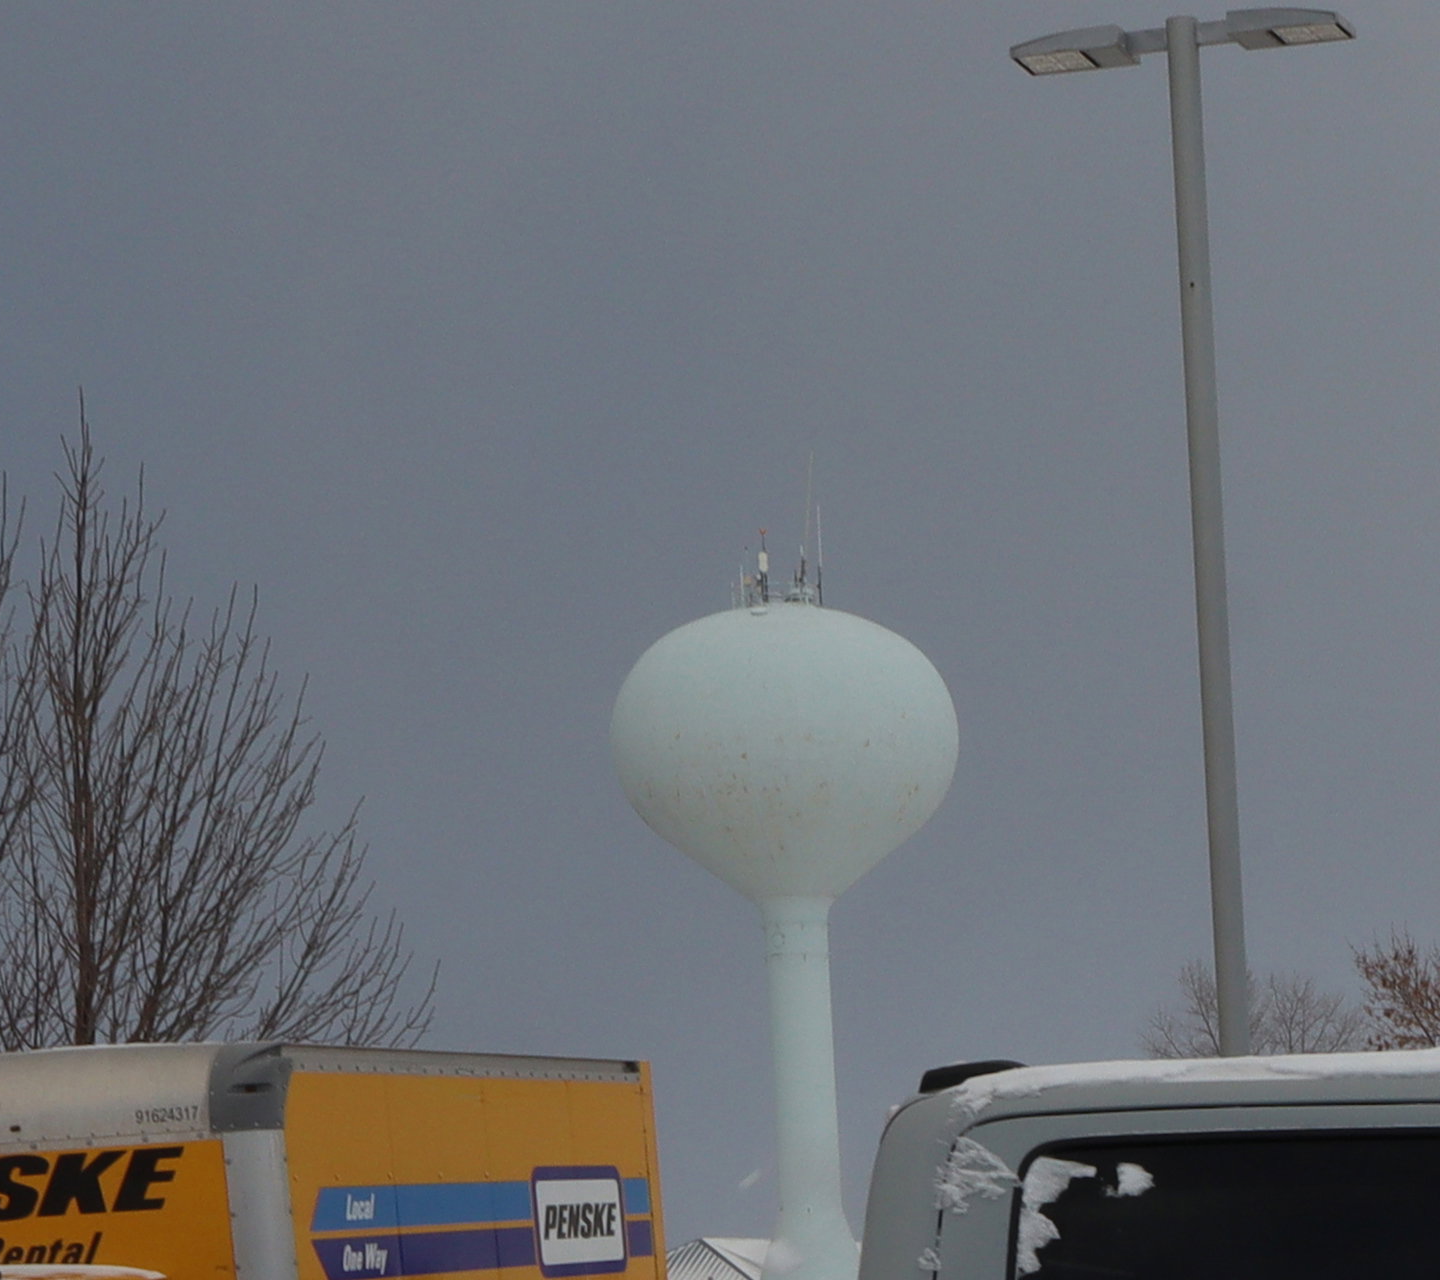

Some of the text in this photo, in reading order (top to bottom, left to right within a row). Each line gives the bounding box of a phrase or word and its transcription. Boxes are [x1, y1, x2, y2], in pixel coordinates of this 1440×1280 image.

[135, 1105, 199, 1125] 91624317
[346, 1193, 375, 1221] Local
[543, 1202, 617, 1241] PENSKE
[342, 1242, 389, 1275] One Way
